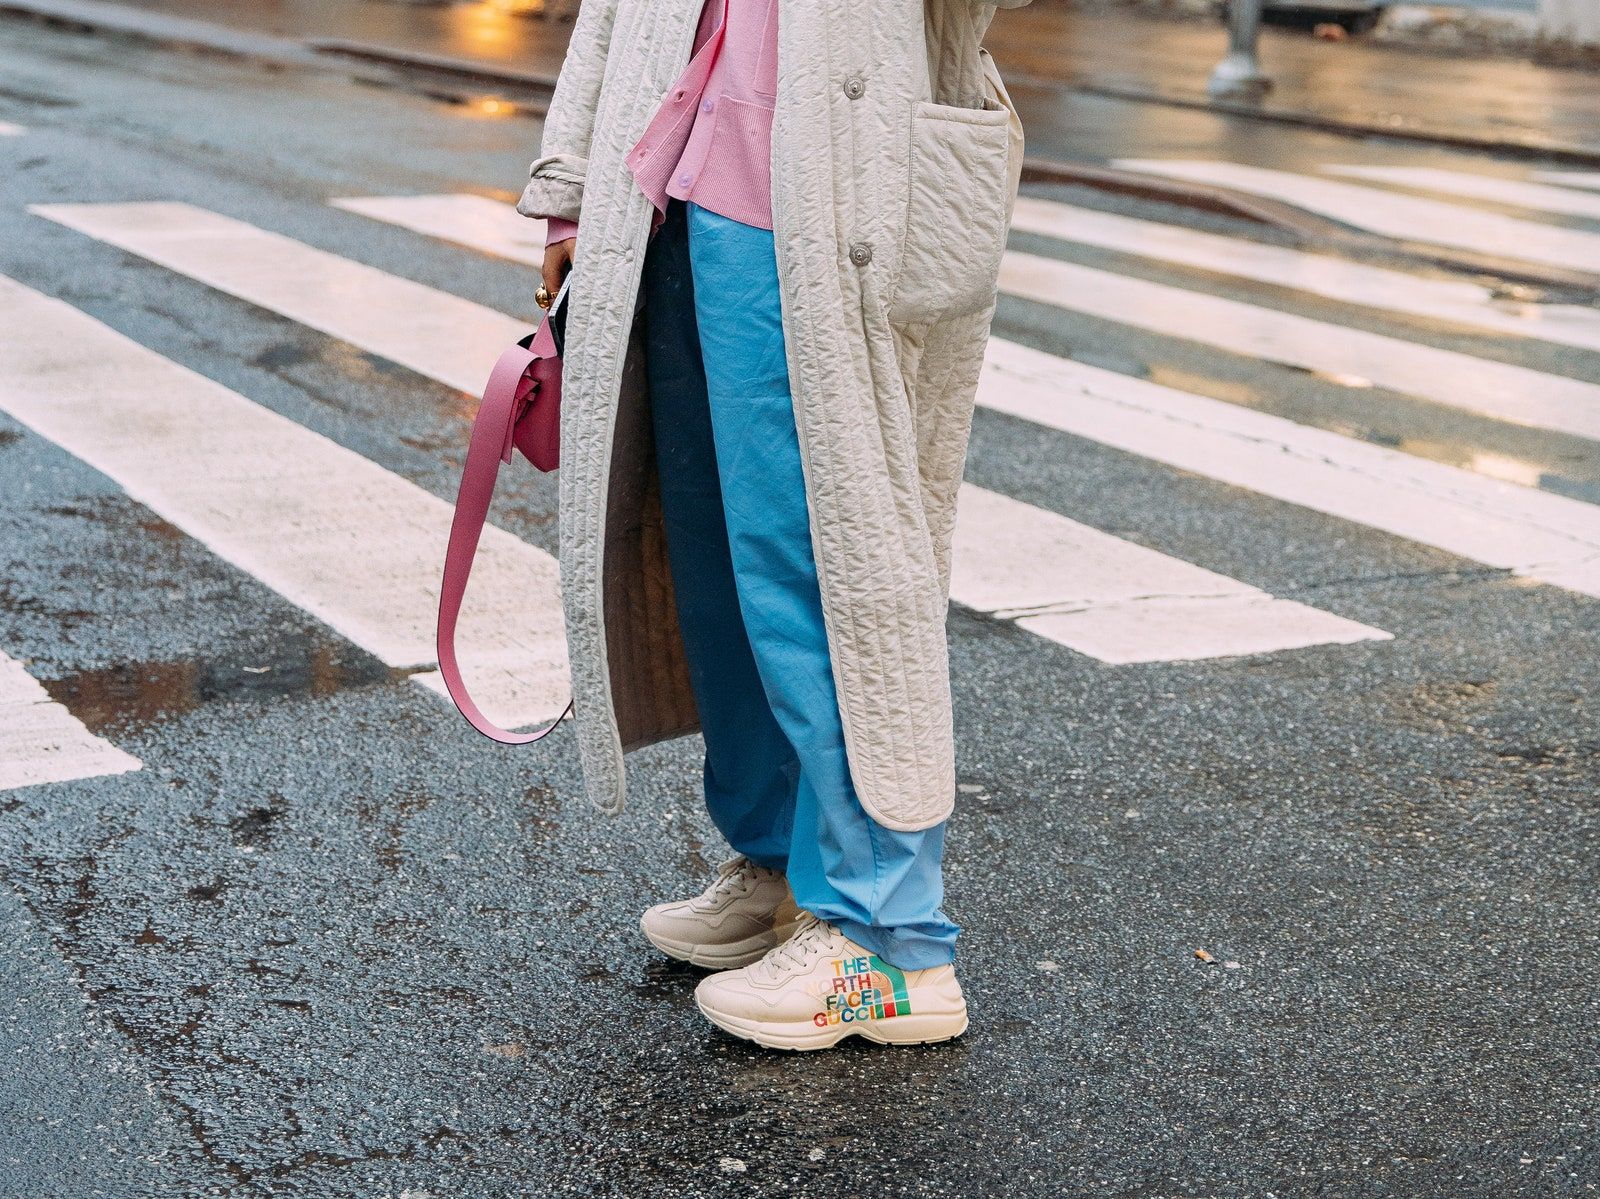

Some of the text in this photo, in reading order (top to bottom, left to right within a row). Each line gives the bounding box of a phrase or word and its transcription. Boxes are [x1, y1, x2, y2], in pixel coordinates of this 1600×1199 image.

[832, 957, 868, 976] THE
[826, 990, 873, 1010] FACE
[814, 1006, 875, 1027] GUCCI
